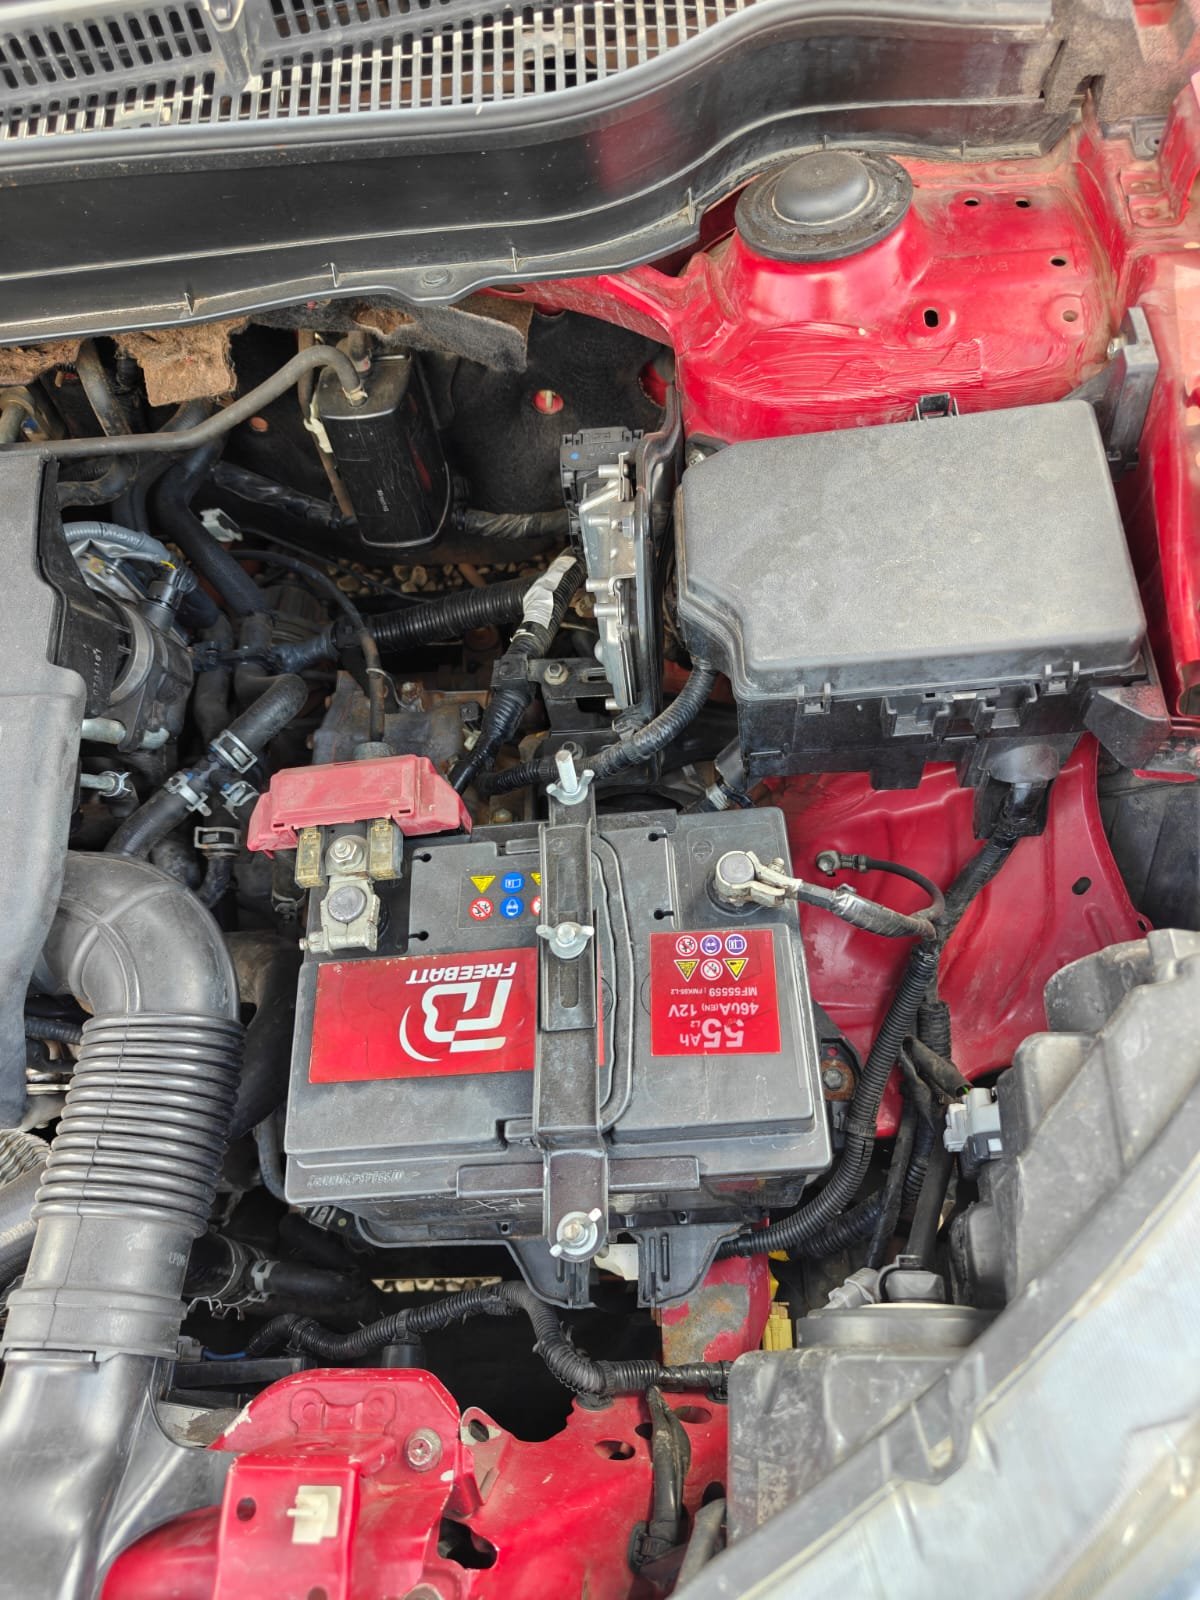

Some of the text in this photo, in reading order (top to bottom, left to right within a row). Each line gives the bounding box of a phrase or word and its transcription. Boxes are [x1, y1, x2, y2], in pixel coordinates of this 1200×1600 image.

[405, 961, 517, 985] FREEBATT
[708, 986, 758, 997] MF55559
[668, 1003, 698, 1018] 12V
[689, 1020, 701, 1028] L2
[679, 1018, 745, 1049] 55 Ah
